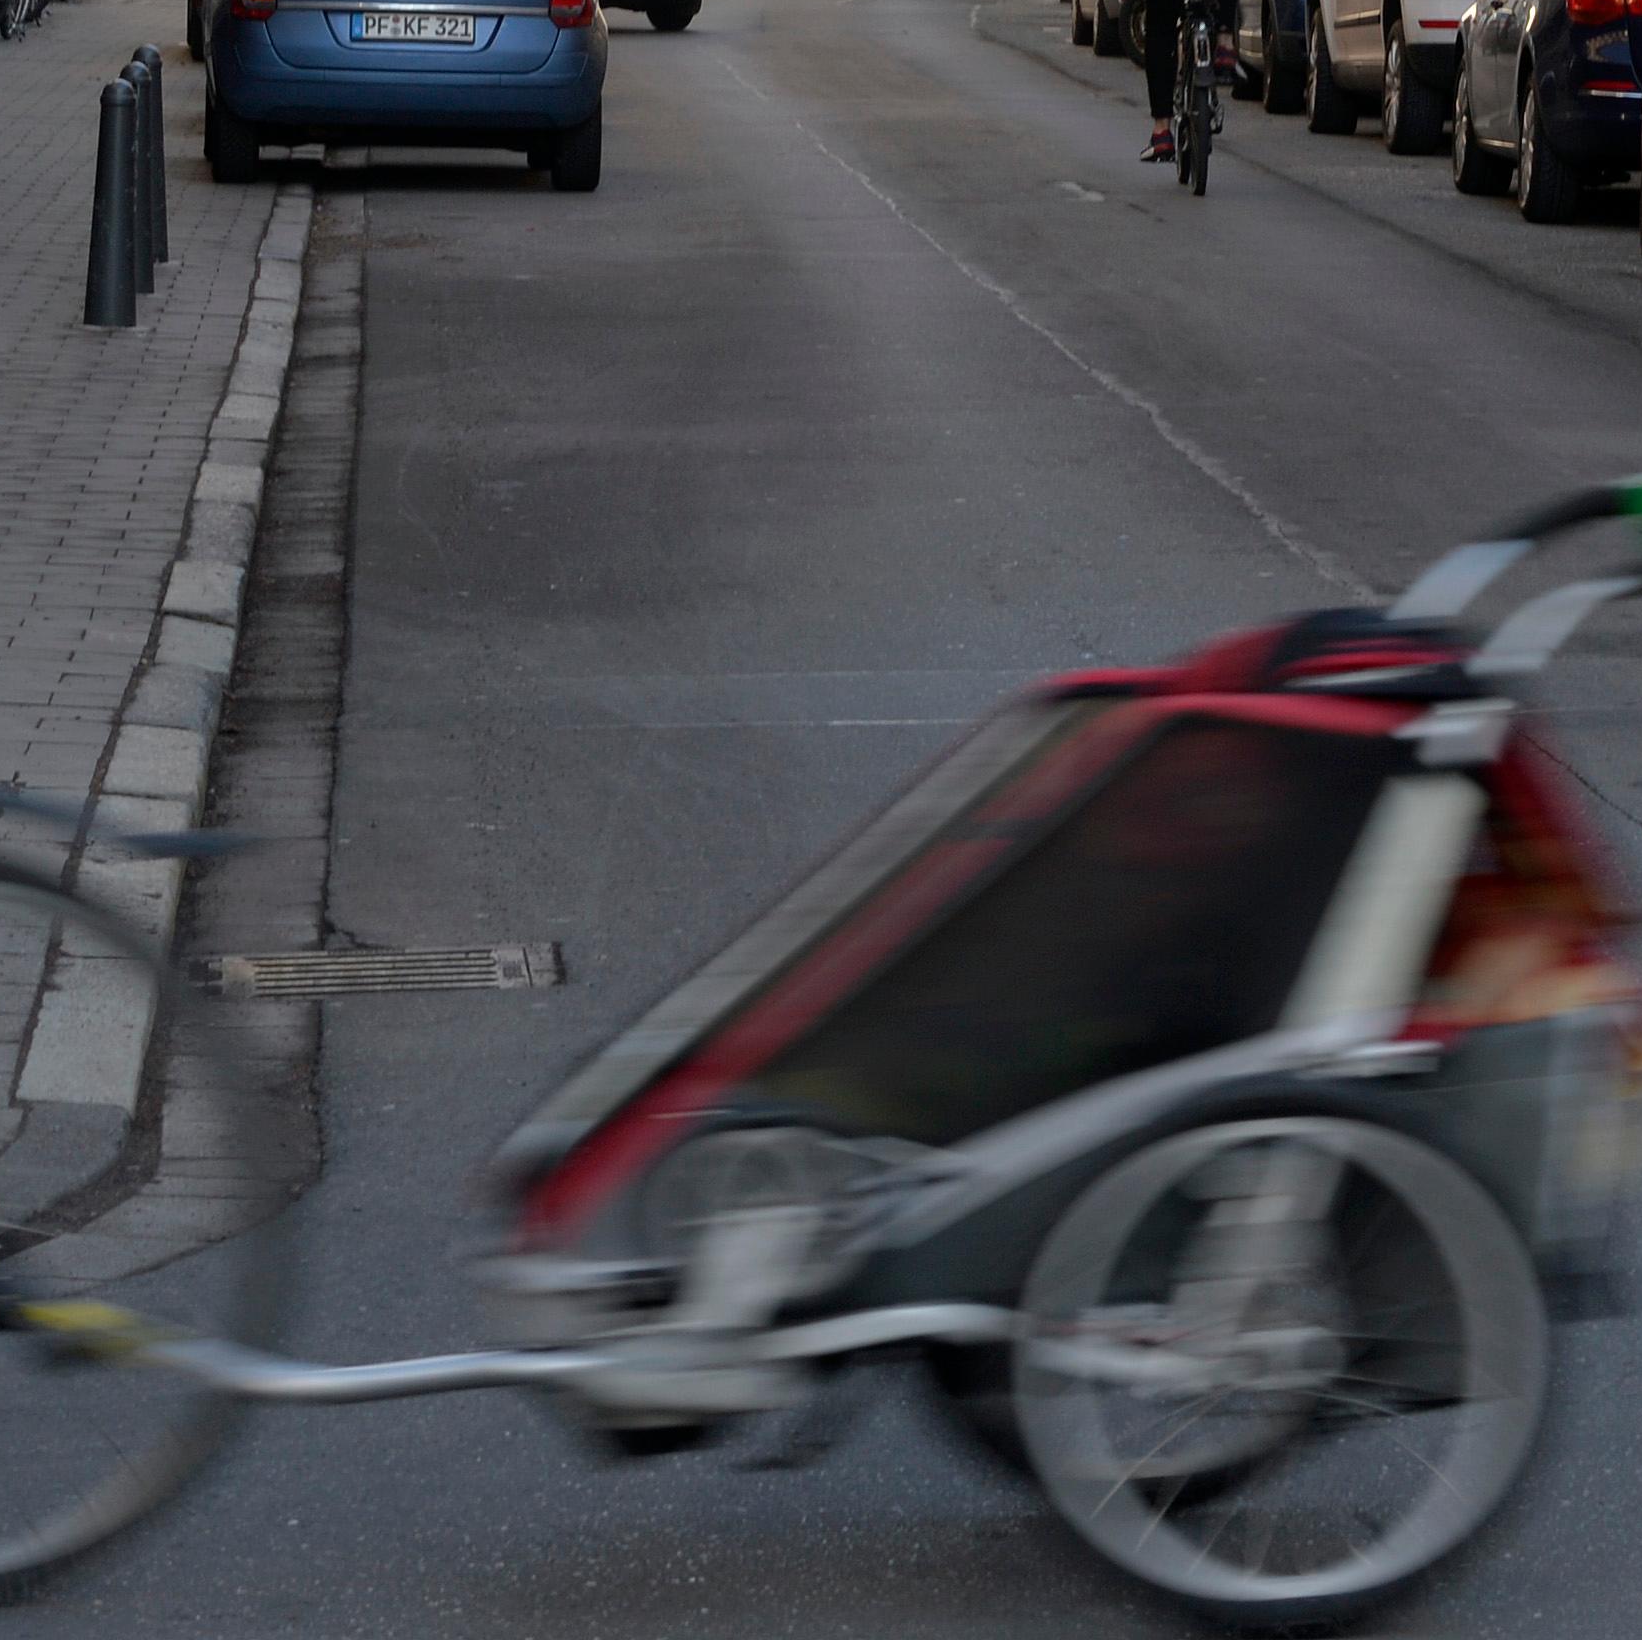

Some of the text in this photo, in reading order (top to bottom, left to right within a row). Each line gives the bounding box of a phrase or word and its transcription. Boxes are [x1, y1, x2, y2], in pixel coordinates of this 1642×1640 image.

[365, 17, 471, 37] PF KF 321
